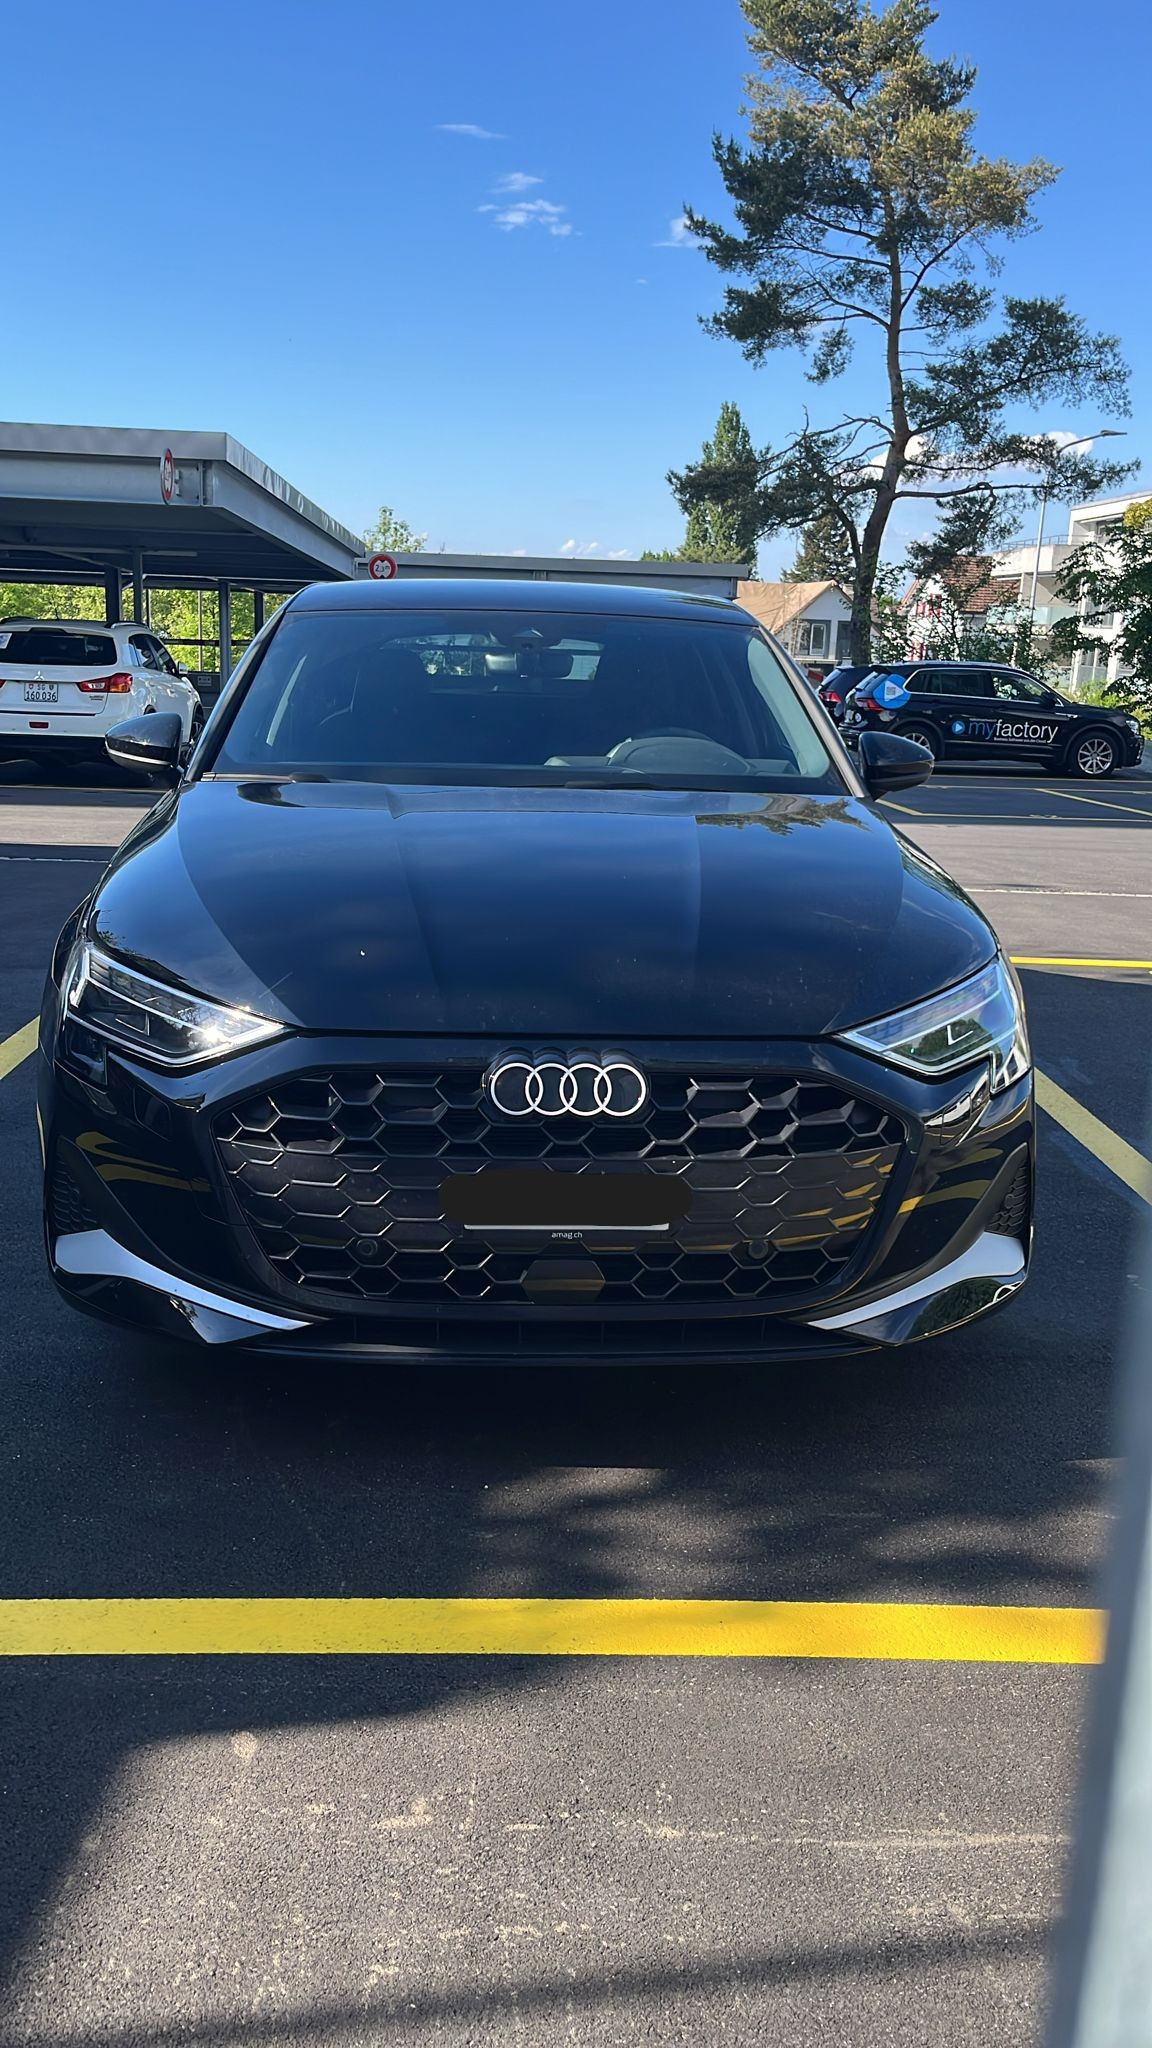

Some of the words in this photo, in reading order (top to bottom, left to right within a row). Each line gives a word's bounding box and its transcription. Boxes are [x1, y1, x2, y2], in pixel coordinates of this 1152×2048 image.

[26, 690, 40, 700] 160
[42, 691, 57, 701] 036
[968, 719, 1059, 744] myfactory
[551, 1231, 583, 1240] amag.ch
